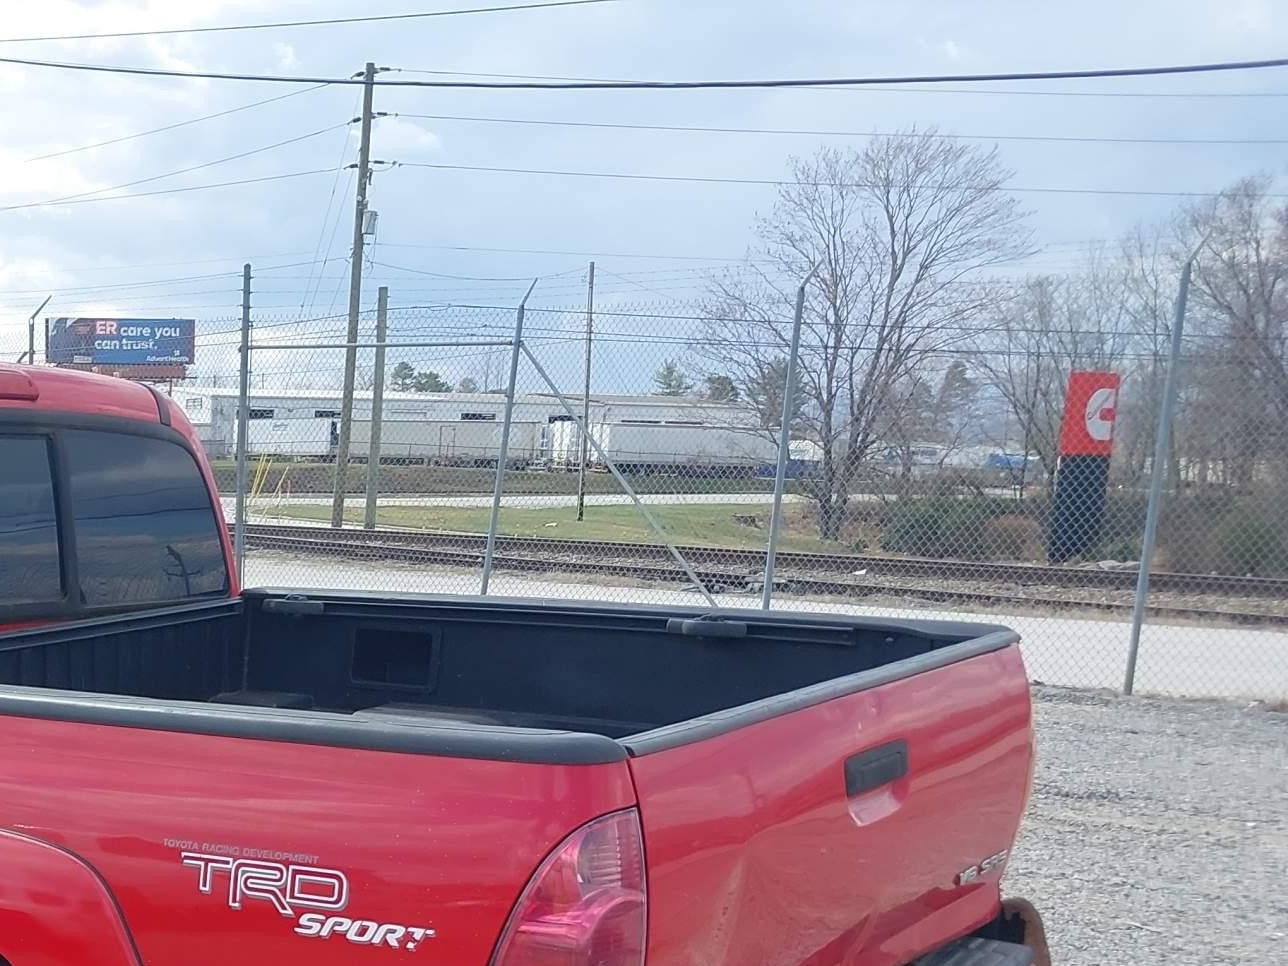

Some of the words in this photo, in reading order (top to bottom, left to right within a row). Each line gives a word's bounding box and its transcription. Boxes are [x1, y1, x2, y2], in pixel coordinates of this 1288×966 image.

[95, 320, 117, 335] ER
[120, 326, 153, 337] care
[154, 326, 180, 339] you
[94, 339, 120, 350] can
[121, 337, 158, 350] trust.
[163, 838, 199, 851] TOYOTA
[201, 842, 240, 856] RACING
[242, 847, 320, 865] DEVELOPMENT
[181, 851, 350, 917] TRD
[294, 912, 436, 951] SPORT
